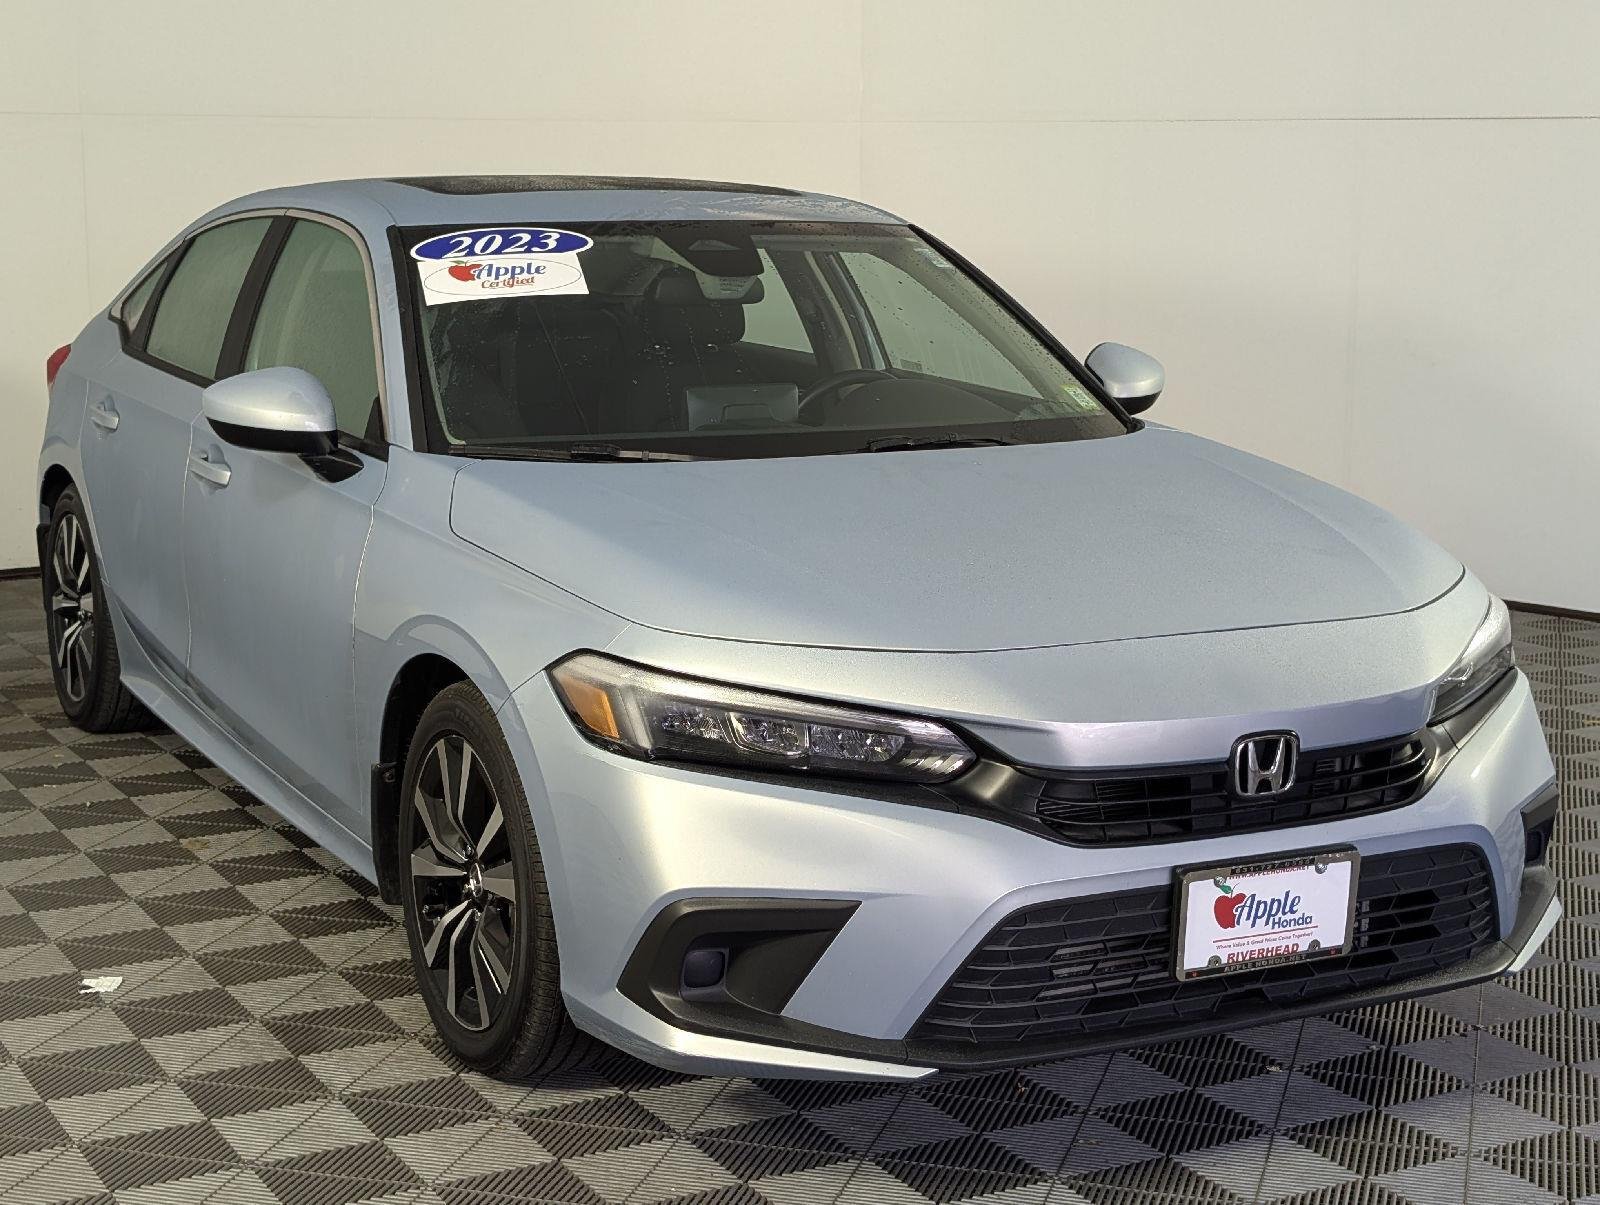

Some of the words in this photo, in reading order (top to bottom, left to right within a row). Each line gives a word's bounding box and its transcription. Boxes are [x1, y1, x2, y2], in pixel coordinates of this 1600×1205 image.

[441, 232, 561, 258] 2023
[473, 262, 547, 281] Apple
[481, 276, 535, 289] Certified
[1235, 890, 1301, 928] Apple
[1271, 912, 1313, 929] Honda
[1227, 943, 1300, 964] RIVERHEAD
[1224, 963, 1253, 973] APPLE
